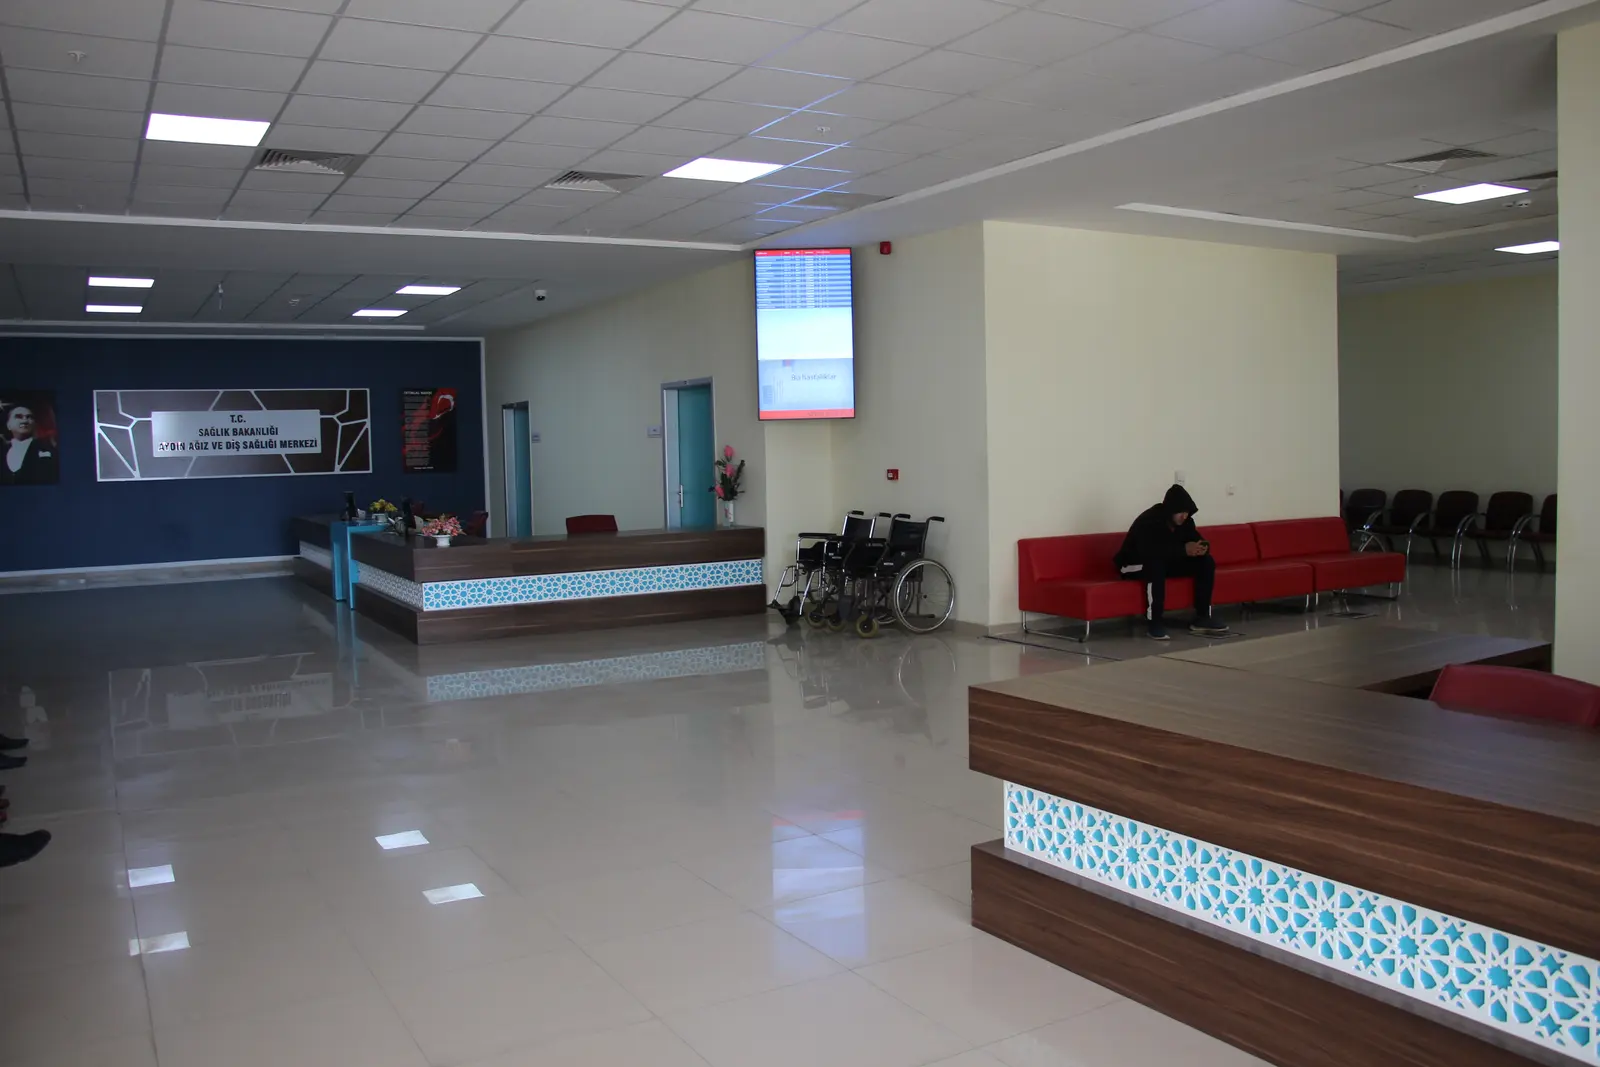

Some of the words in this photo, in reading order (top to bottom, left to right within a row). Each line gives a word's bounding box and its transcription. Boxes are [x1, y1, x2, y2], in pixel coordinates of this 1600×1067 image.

[229, 414, 246, 423] T.C.
[198, 426, 230, 437] SAĞLIK
[232, 425, 278, 436] BAKANLIĞI
[158, 441, 185, 451] AYDIN
[188, 439, 209, 450] AĞIZ
[212, 441, 223, 450] VE
[226, 439, 240, 451] DİŞ
[243, 438, 277, 450] SAĞLIĞI
[280, 437, 318, 449] MERKEZİ
